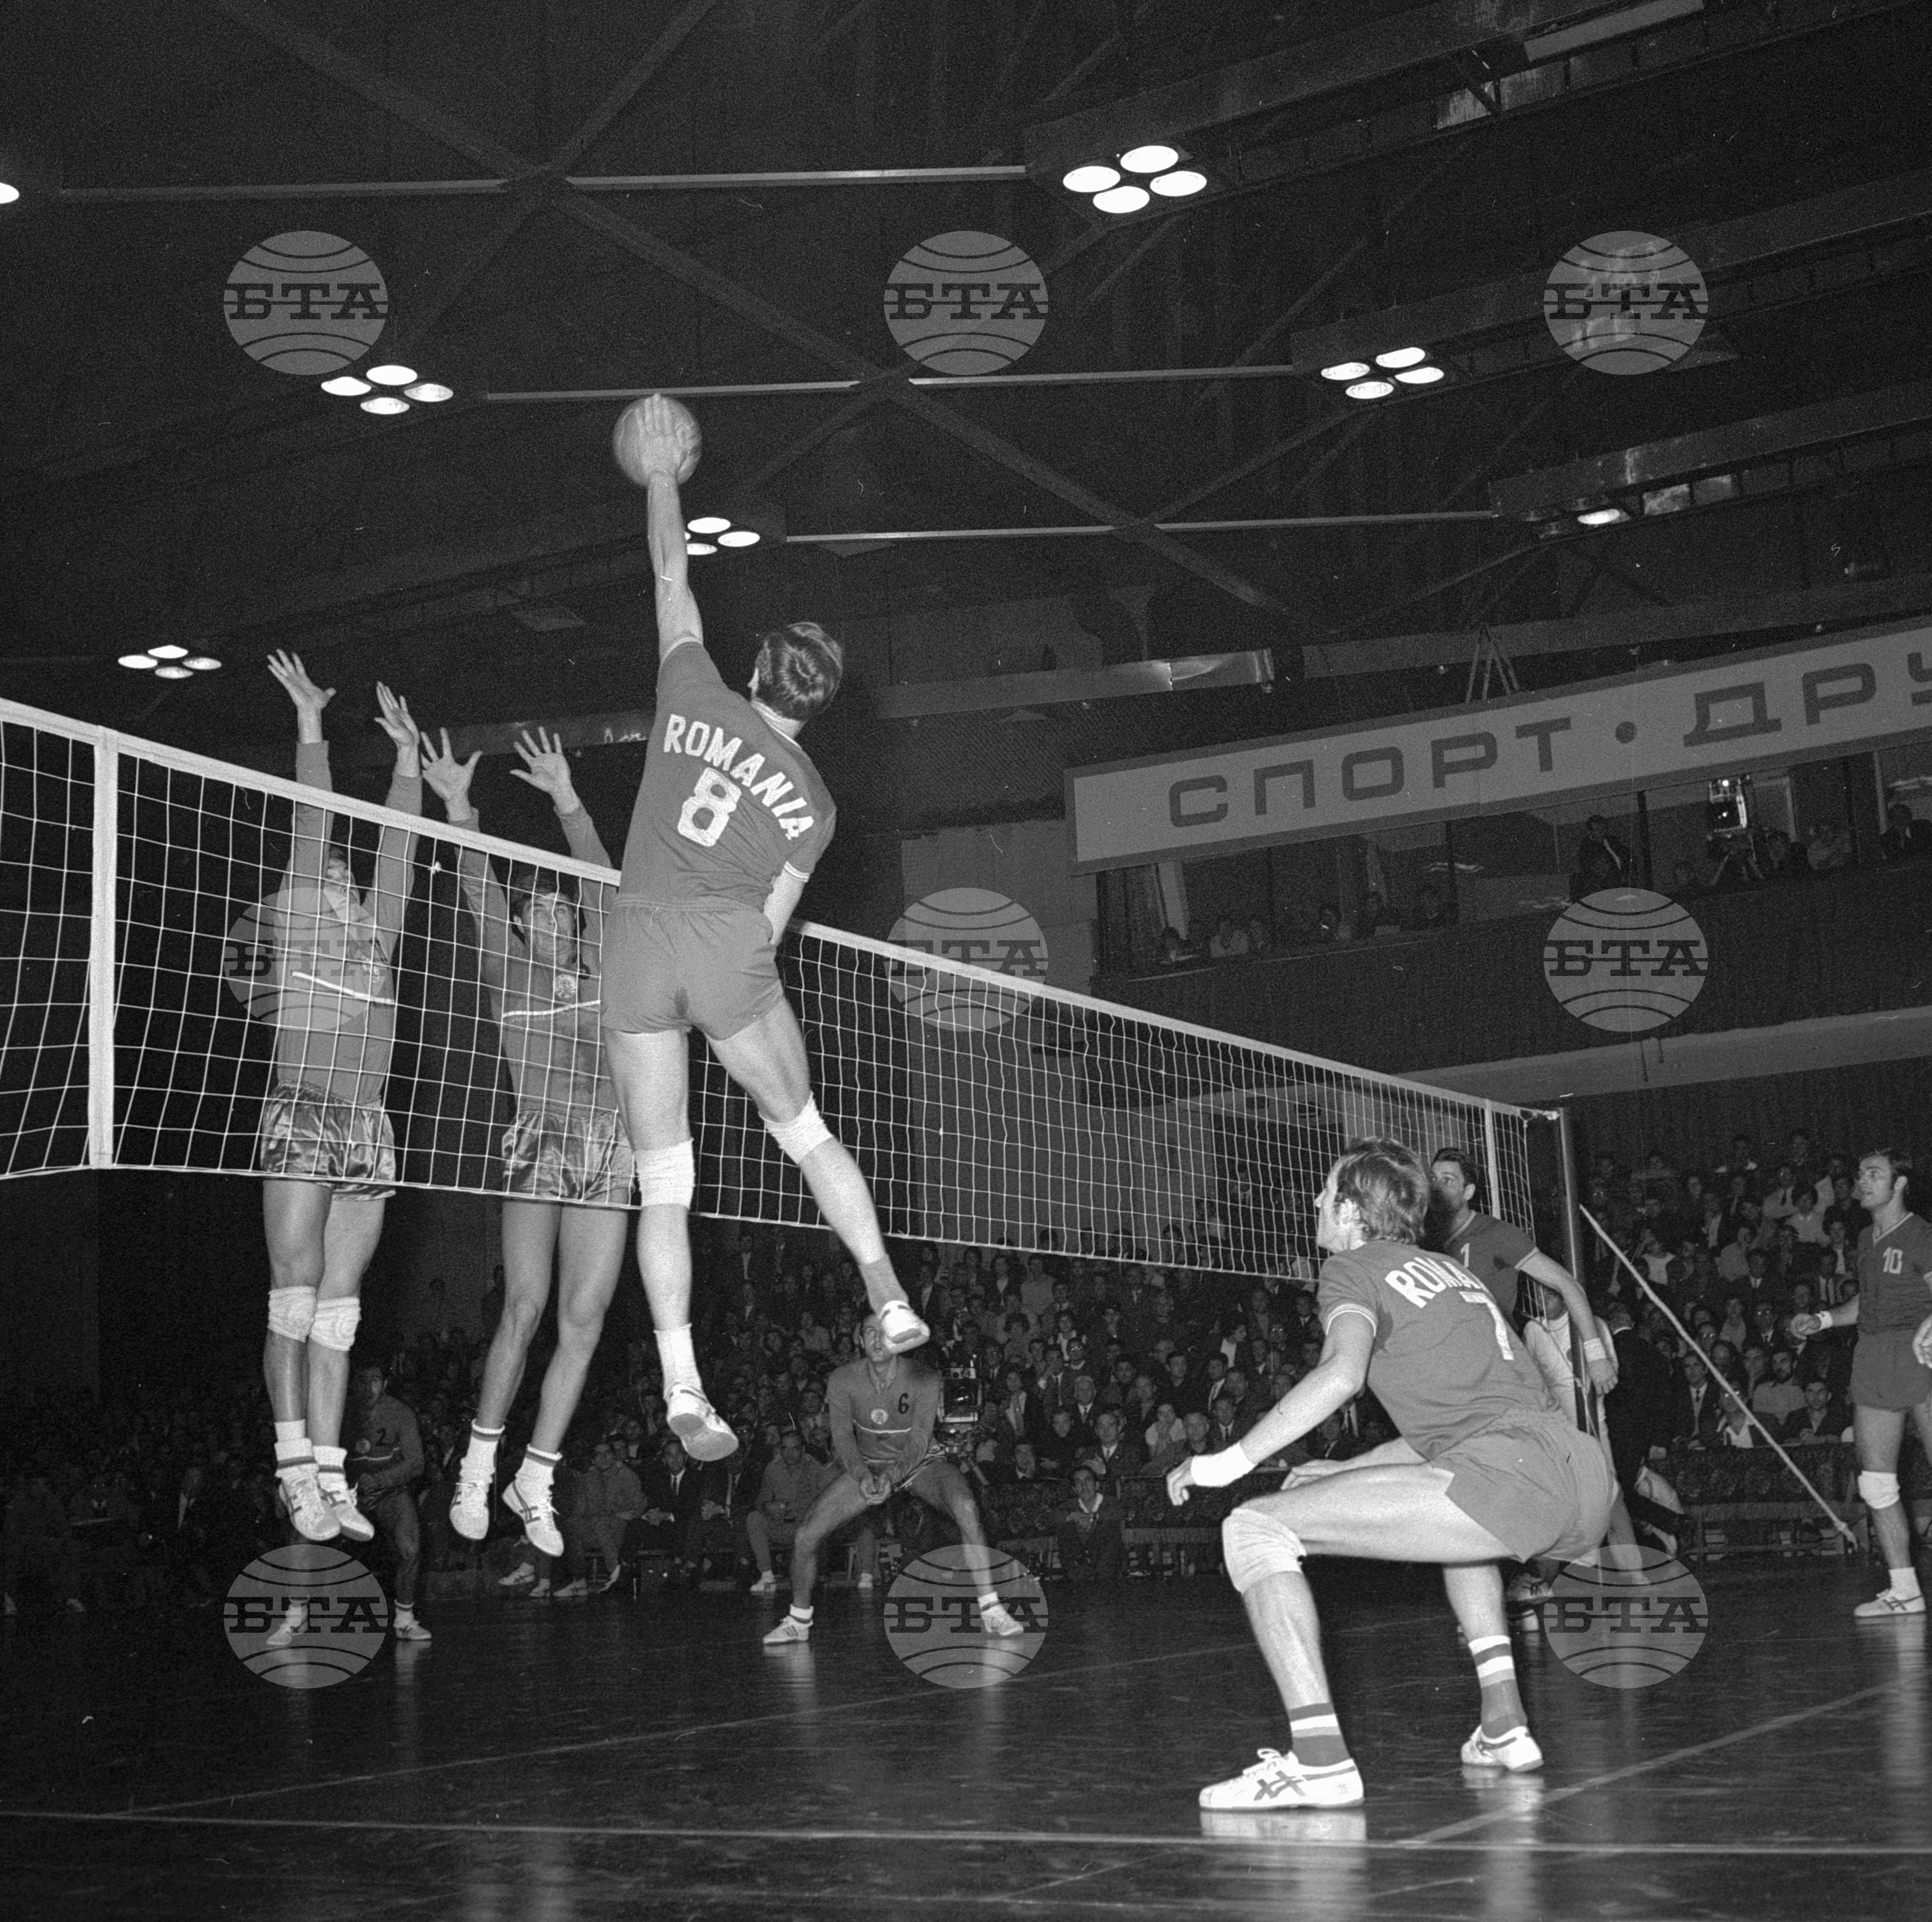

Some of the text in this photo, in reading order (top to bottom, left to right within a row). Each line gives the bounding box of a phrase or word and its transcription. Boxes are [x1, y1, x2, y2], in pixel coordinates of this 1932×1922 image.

[664, 714, 814, 840] ROMANIA
[1169, 717, 1571, 828] СПОРТ
[678, 767, 742, 847] 8
[1460, 1243, 1470, 1268] 1
[1883, 1246, 1904, 1274] 10
[1385, 1257, 1488, 1309] ROMA
[1458, 1290, 1514, 1360] 7
[898, 1392, 909, 1414] 6
[374, 1427, 387, 1446] 2
